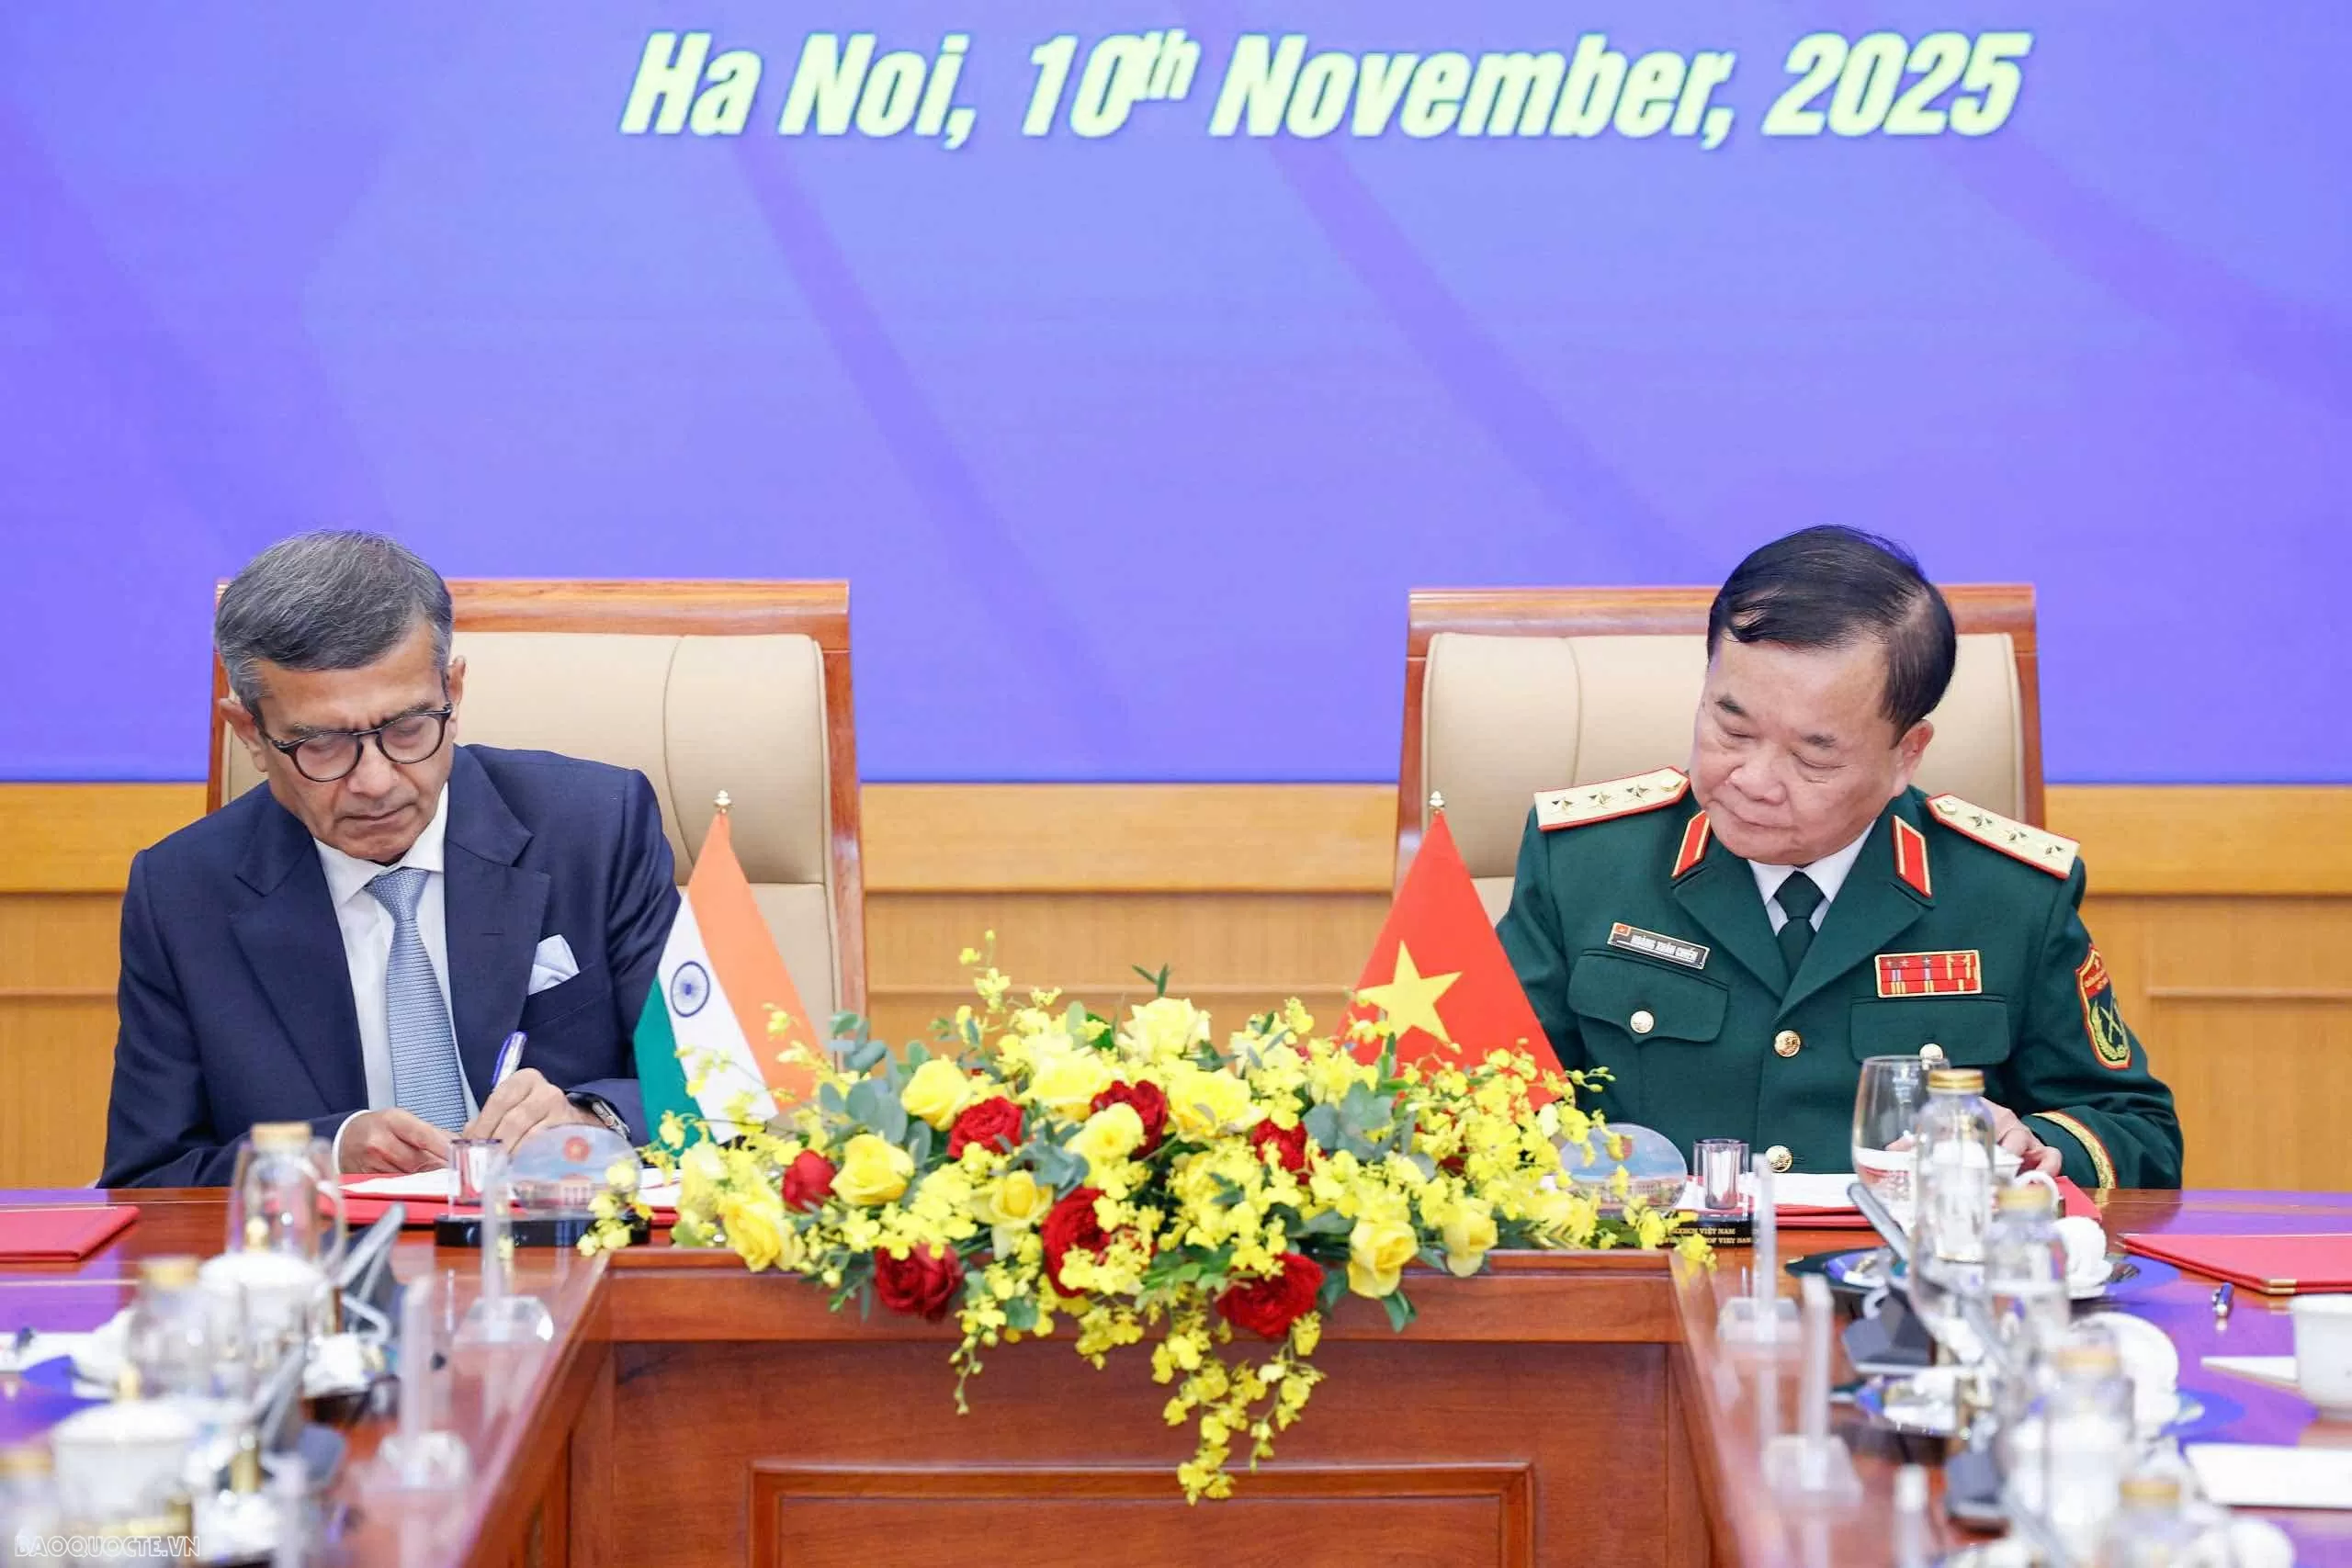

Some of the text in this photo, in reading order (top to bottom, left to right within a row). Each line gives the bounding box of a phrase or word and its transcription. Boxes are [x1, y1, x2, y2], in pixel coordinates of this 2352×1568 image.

[620, 28, 2032, 149] Ha Noi, 10th November, 2025
